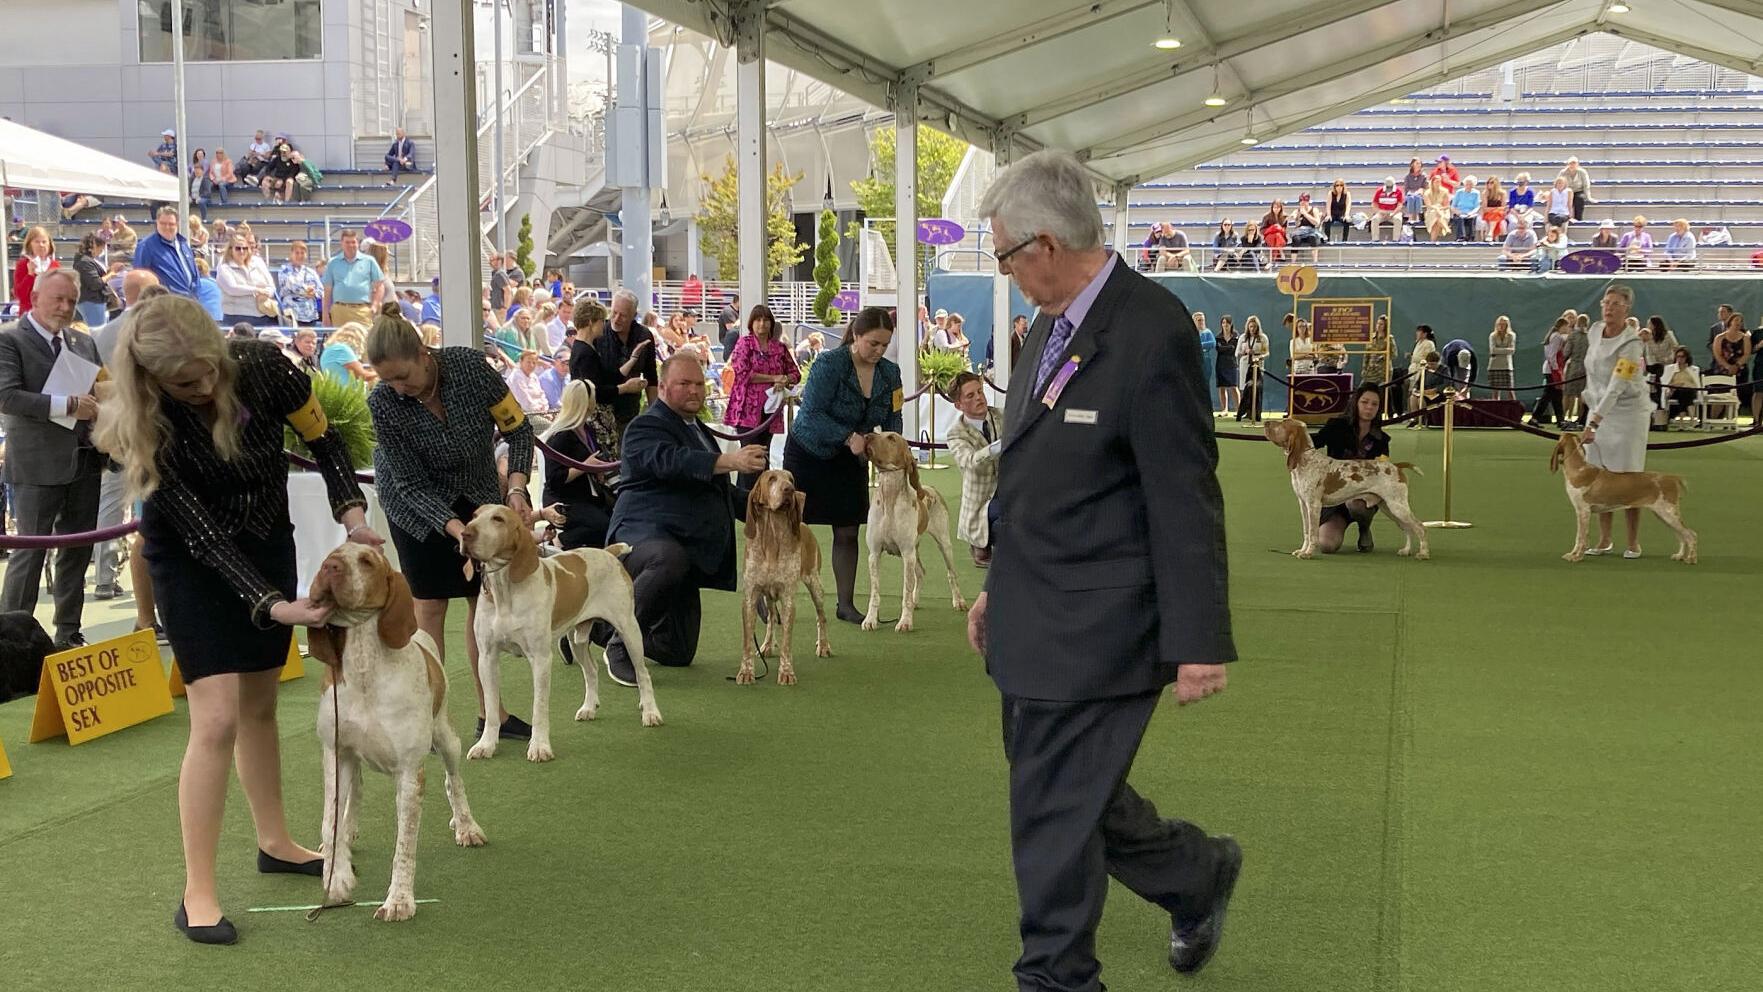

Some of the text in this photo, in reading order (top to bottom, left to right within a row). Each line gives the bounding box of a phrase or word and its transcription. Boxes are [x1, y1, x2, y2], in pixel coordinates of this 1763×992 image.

[1290, 267, 1304, 292] 6
[57, 648, 120, 683] BEST OF
[65, 668, 137, 706] OPPOSITE
[71, 706, 102, 732] SEX
